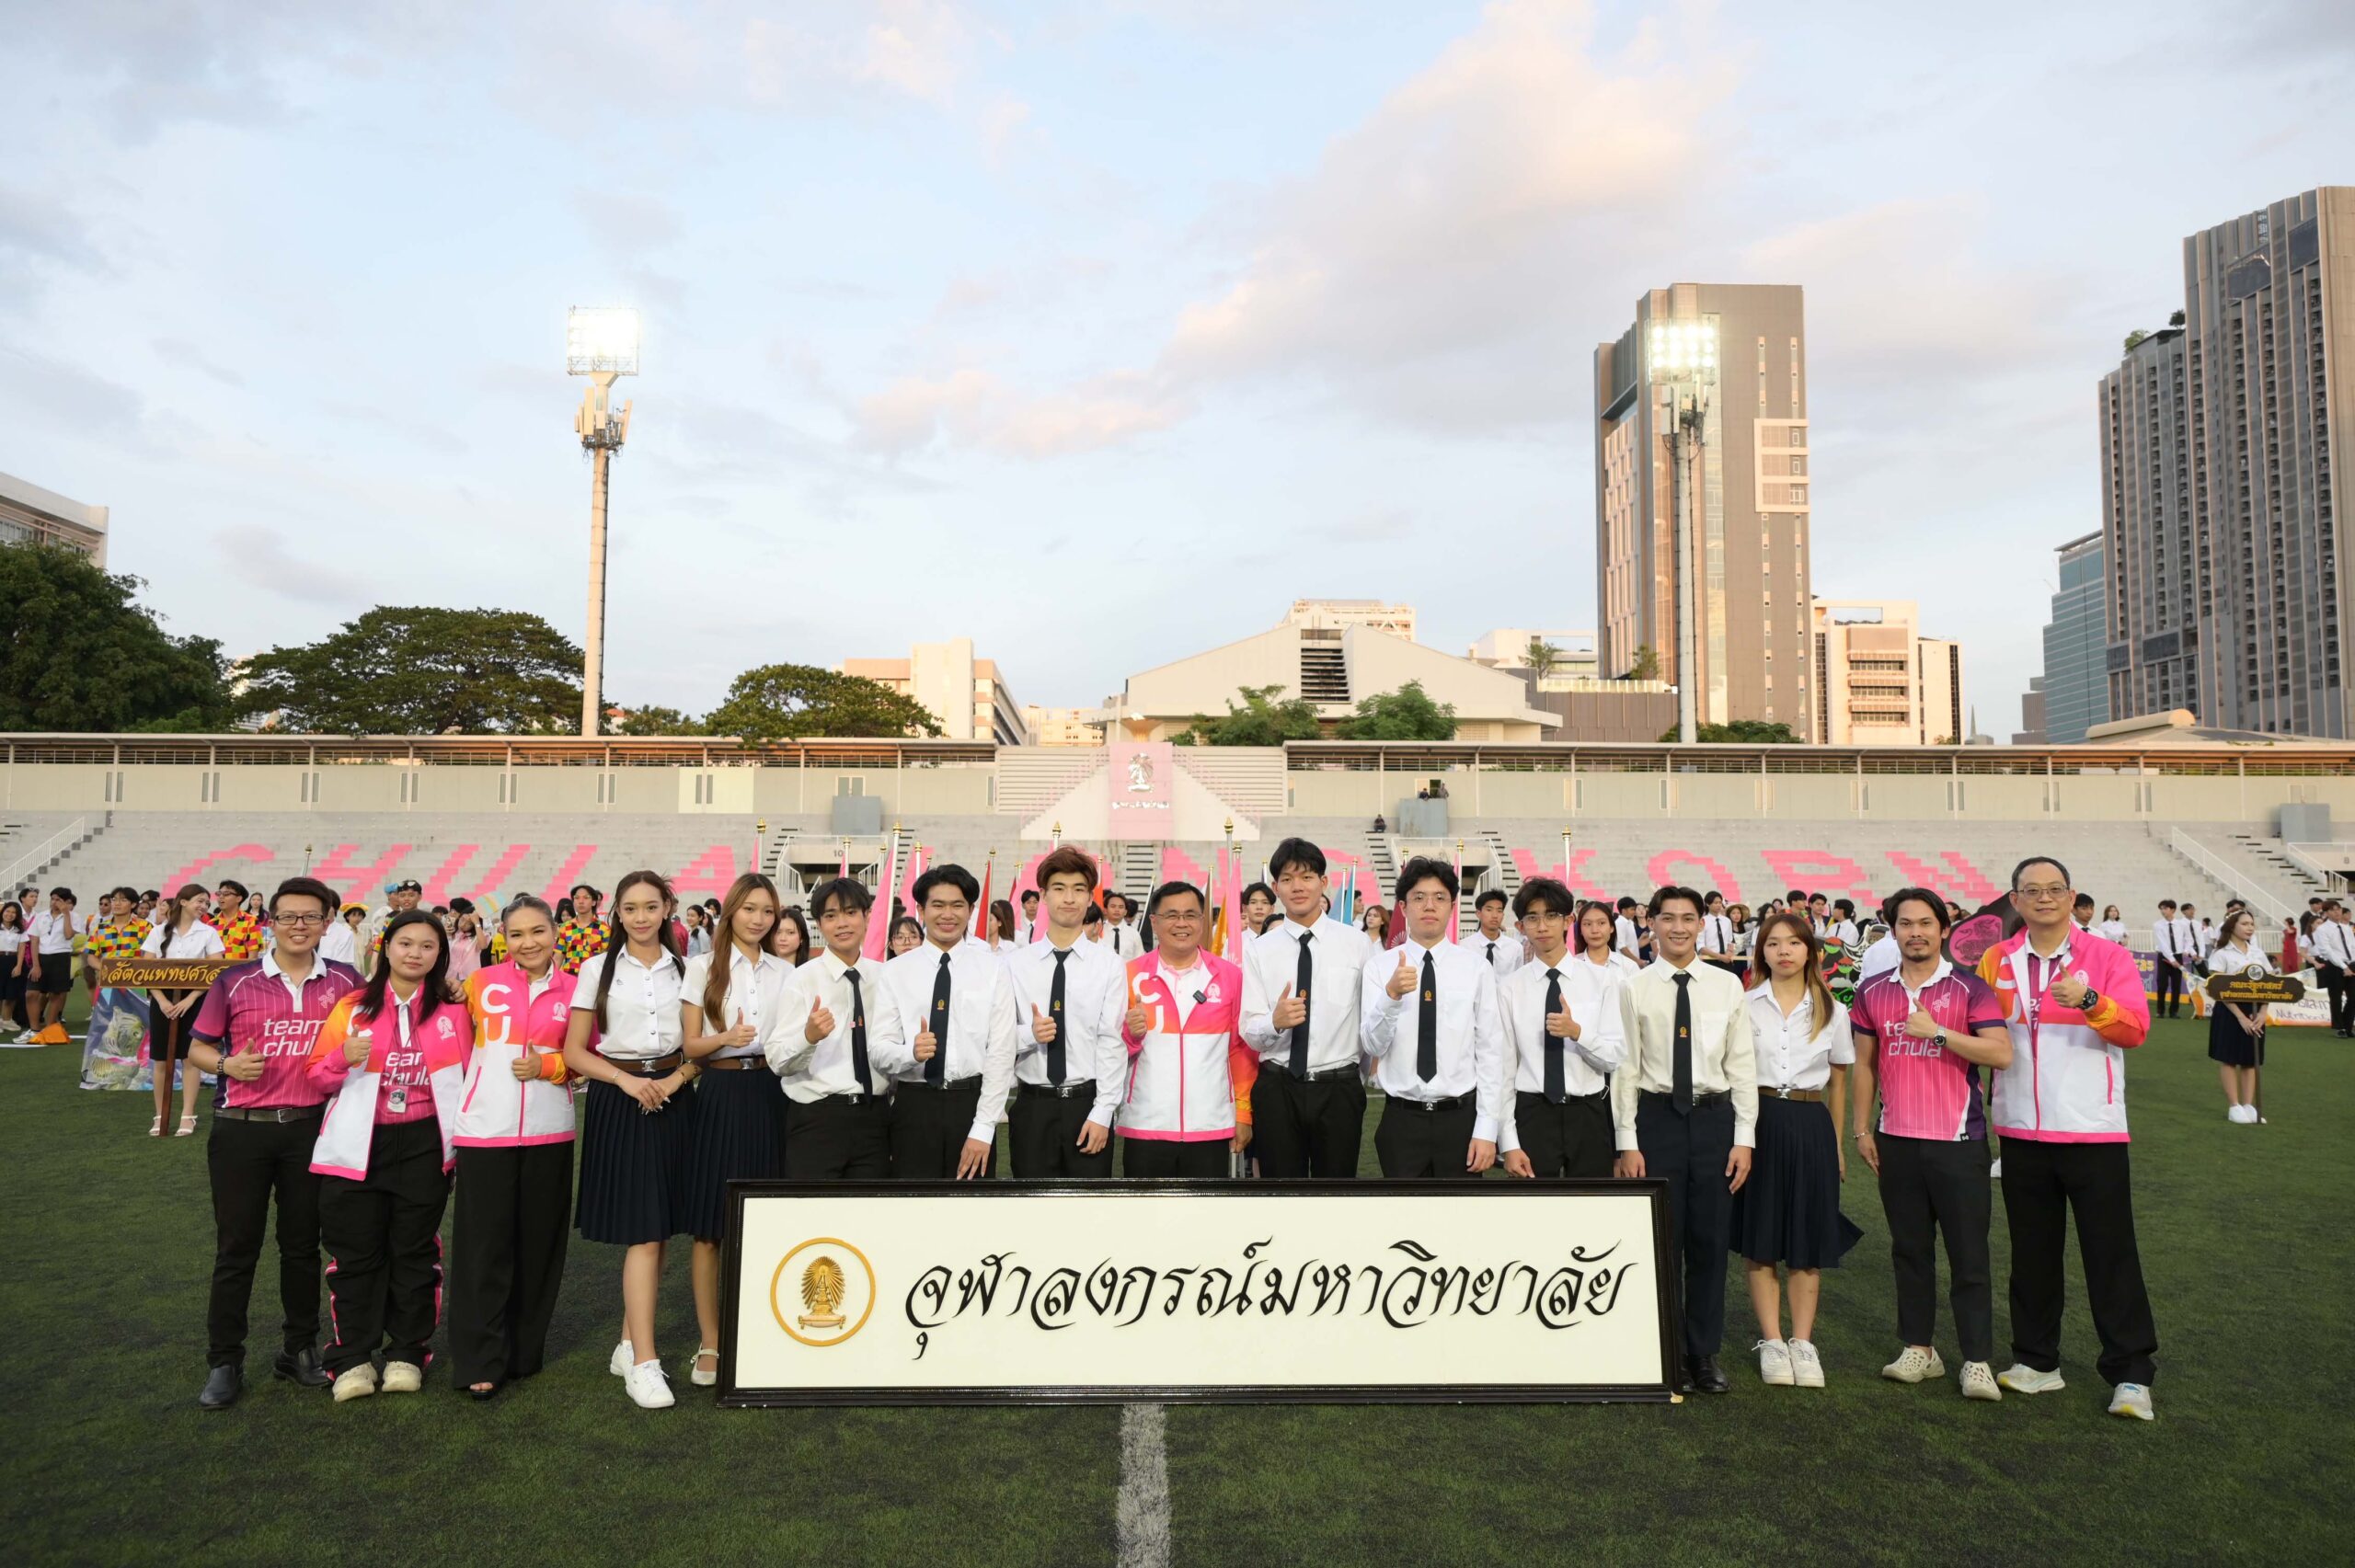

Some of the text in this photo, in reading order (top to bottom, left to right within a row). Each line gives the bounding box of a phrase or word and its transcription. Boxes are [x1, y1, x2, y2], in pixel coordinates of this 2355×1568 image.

[108, 961, 229, 985] สัตวแพทยศาส
[1884, 1020, 1907, 1037] te
[262, 1036, 316, 1058] chul
[1888, 1036, 1942, 1058] chula
[905, 1237, 1636, 1359] จุฬาลงกรณ์มหาวิทยาลัย
